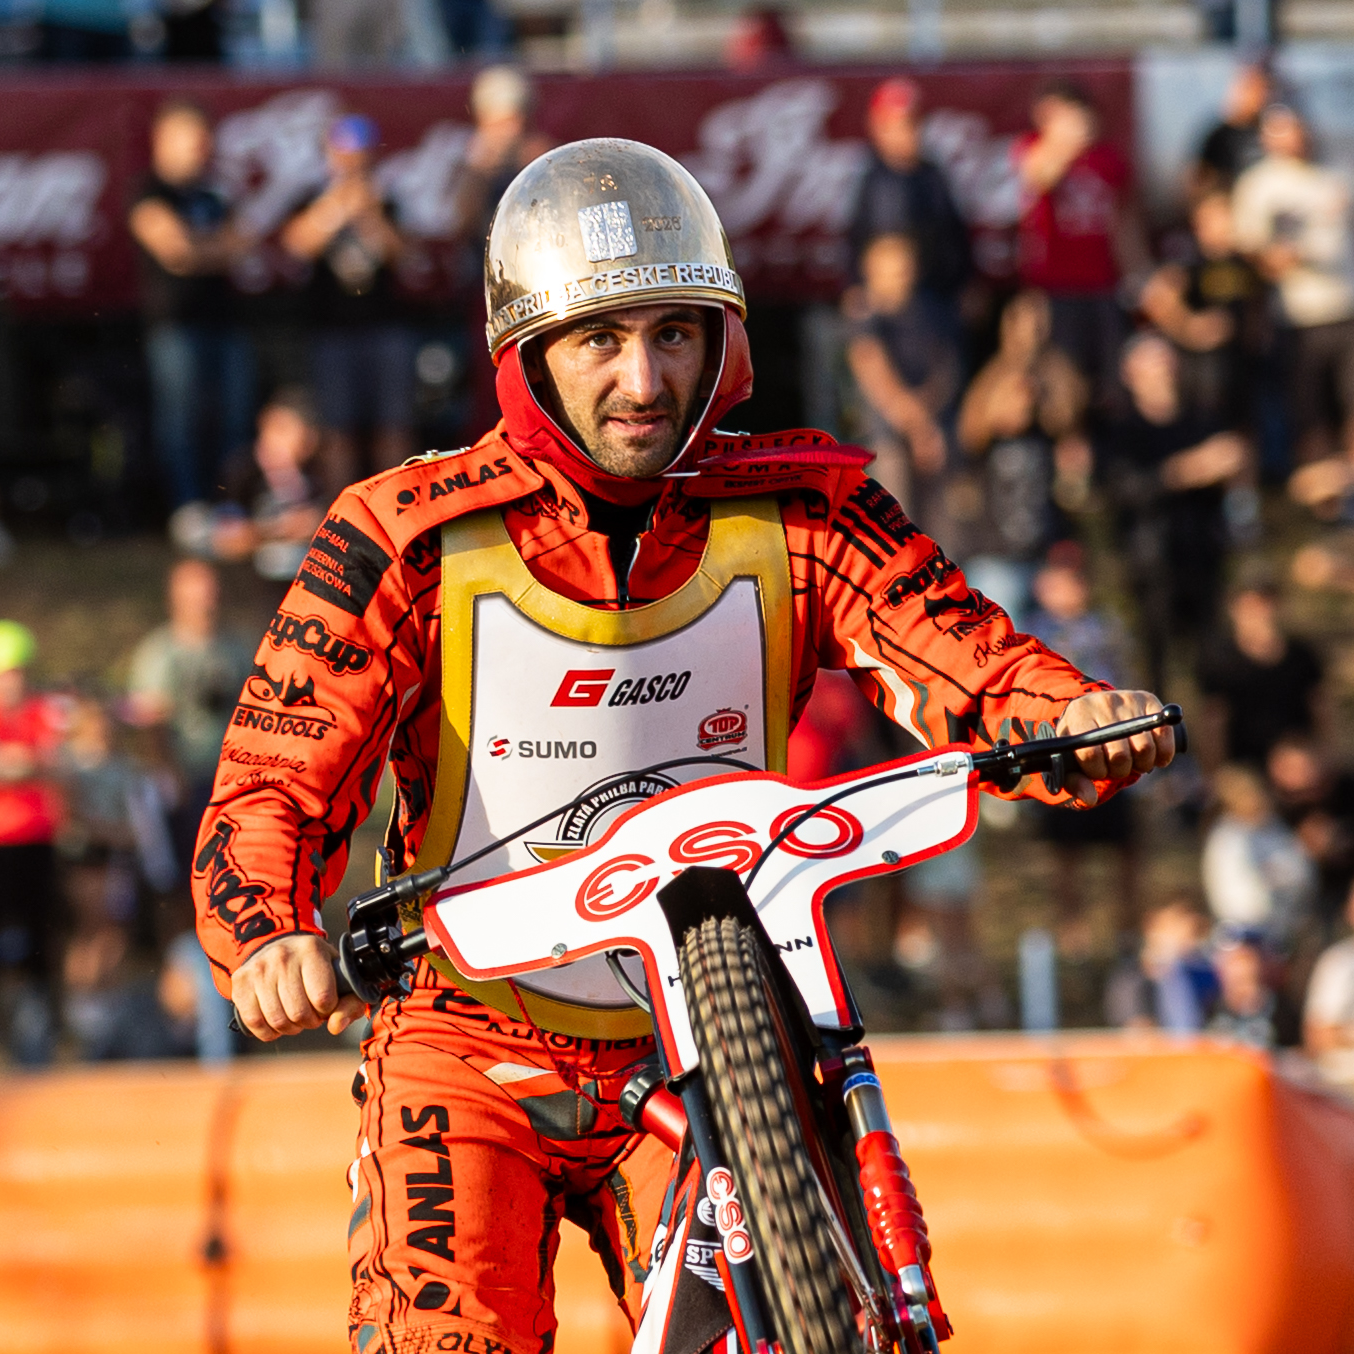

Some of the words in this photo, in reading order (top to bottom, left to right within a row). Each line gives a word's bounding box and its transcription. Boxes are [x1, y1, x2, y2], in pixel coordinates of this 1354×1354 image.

[676, 262, 738, 293] REPUBL
[429, 456, 513, 501] ANLAS
[608, 671, 691, 707] GASCO
[232, 707, 329, 741] ENGTOOLS
[708, 716, 737, 734] TOP
[518, 740, 597, 759] SUMO
[399, 1104, 455, 1262] ANLAS
